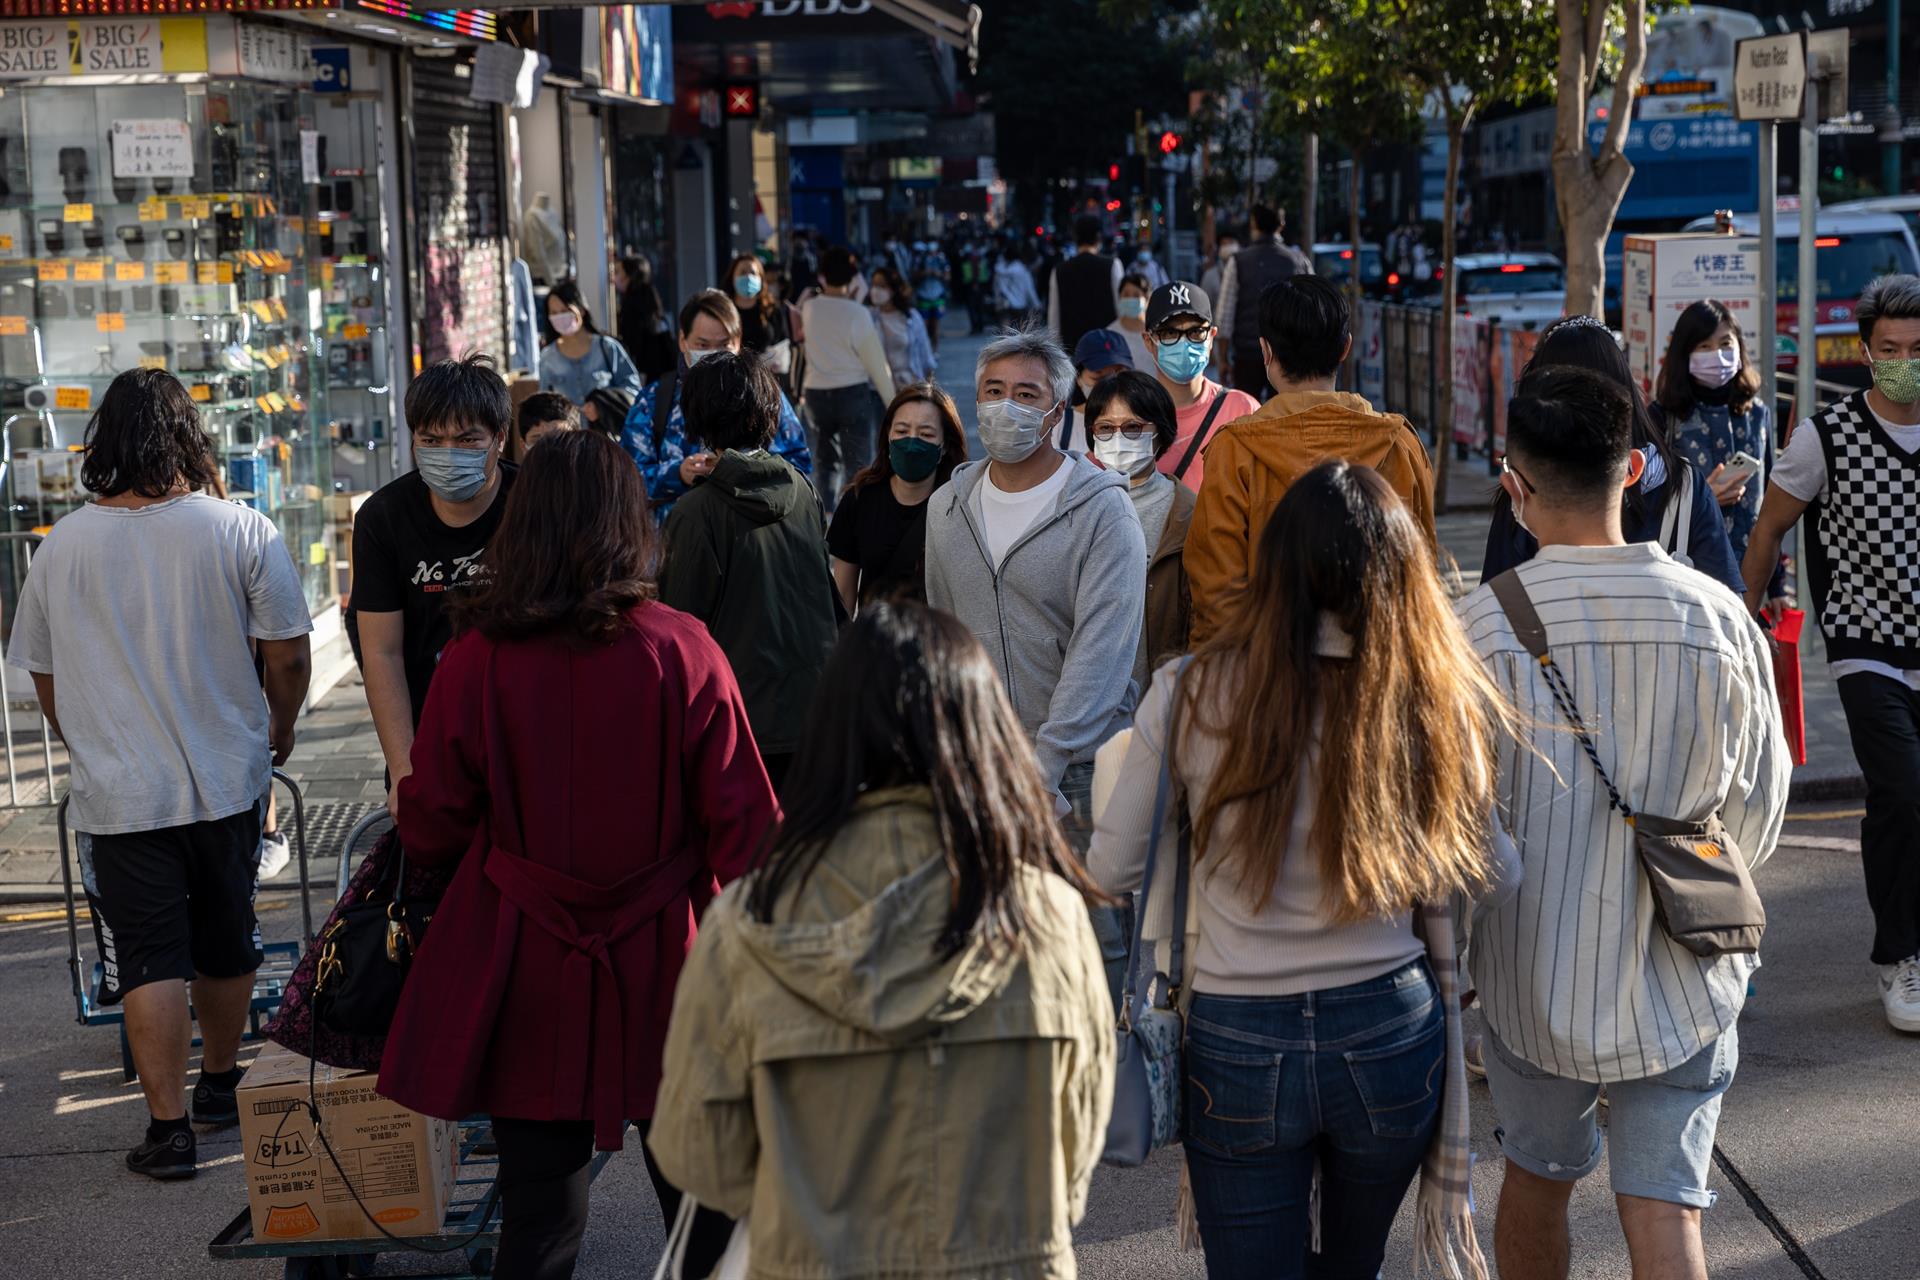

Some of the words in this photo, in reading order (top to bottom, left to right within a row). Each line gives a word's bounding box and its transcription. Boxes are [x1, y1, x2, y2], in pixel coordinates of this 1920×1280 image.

[4, 26, 43, 49] BIG
[95, 24, 136, 47] BIG
[0, 49, 59, 73] SALE
[89, 46, 150, 71] SALE
[1694, 253, 1745, 272] 代寄王
[1169, 284, 1191, 305] NY
[411, 560, 445, 585] No
[355, 1125, 379, 1134] CHINA
[389, 1121, 411, 1130] MADE
[261, 1140, 304, 1158] T143
[254, 1172, 288, 1182] Crumbs
[291, 1169, 317, 1179] Bread
